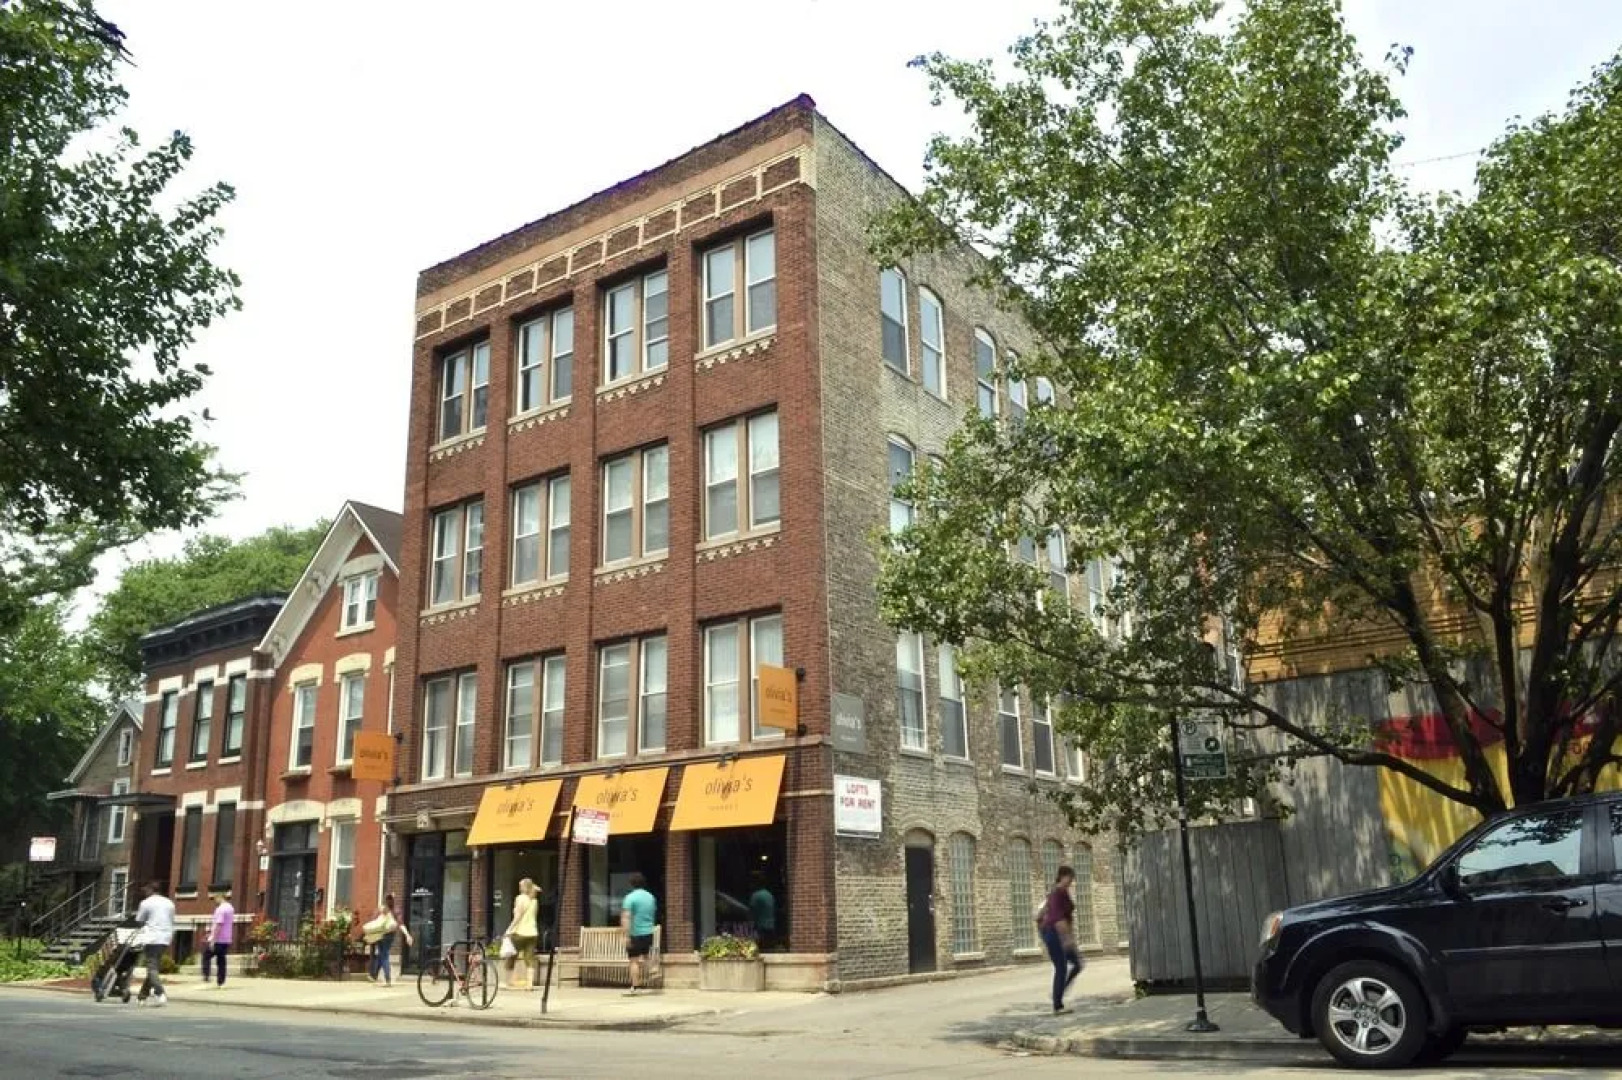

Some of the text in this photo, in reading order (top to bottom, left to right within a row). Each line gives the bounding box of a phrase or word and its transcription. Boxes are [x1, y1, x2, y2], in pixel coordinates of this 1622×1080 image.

[705, 775, 753, 796] olivia's
[845, 783, 869, 796] LOFTS
[840, 796, 876, 810] FOR RENT
